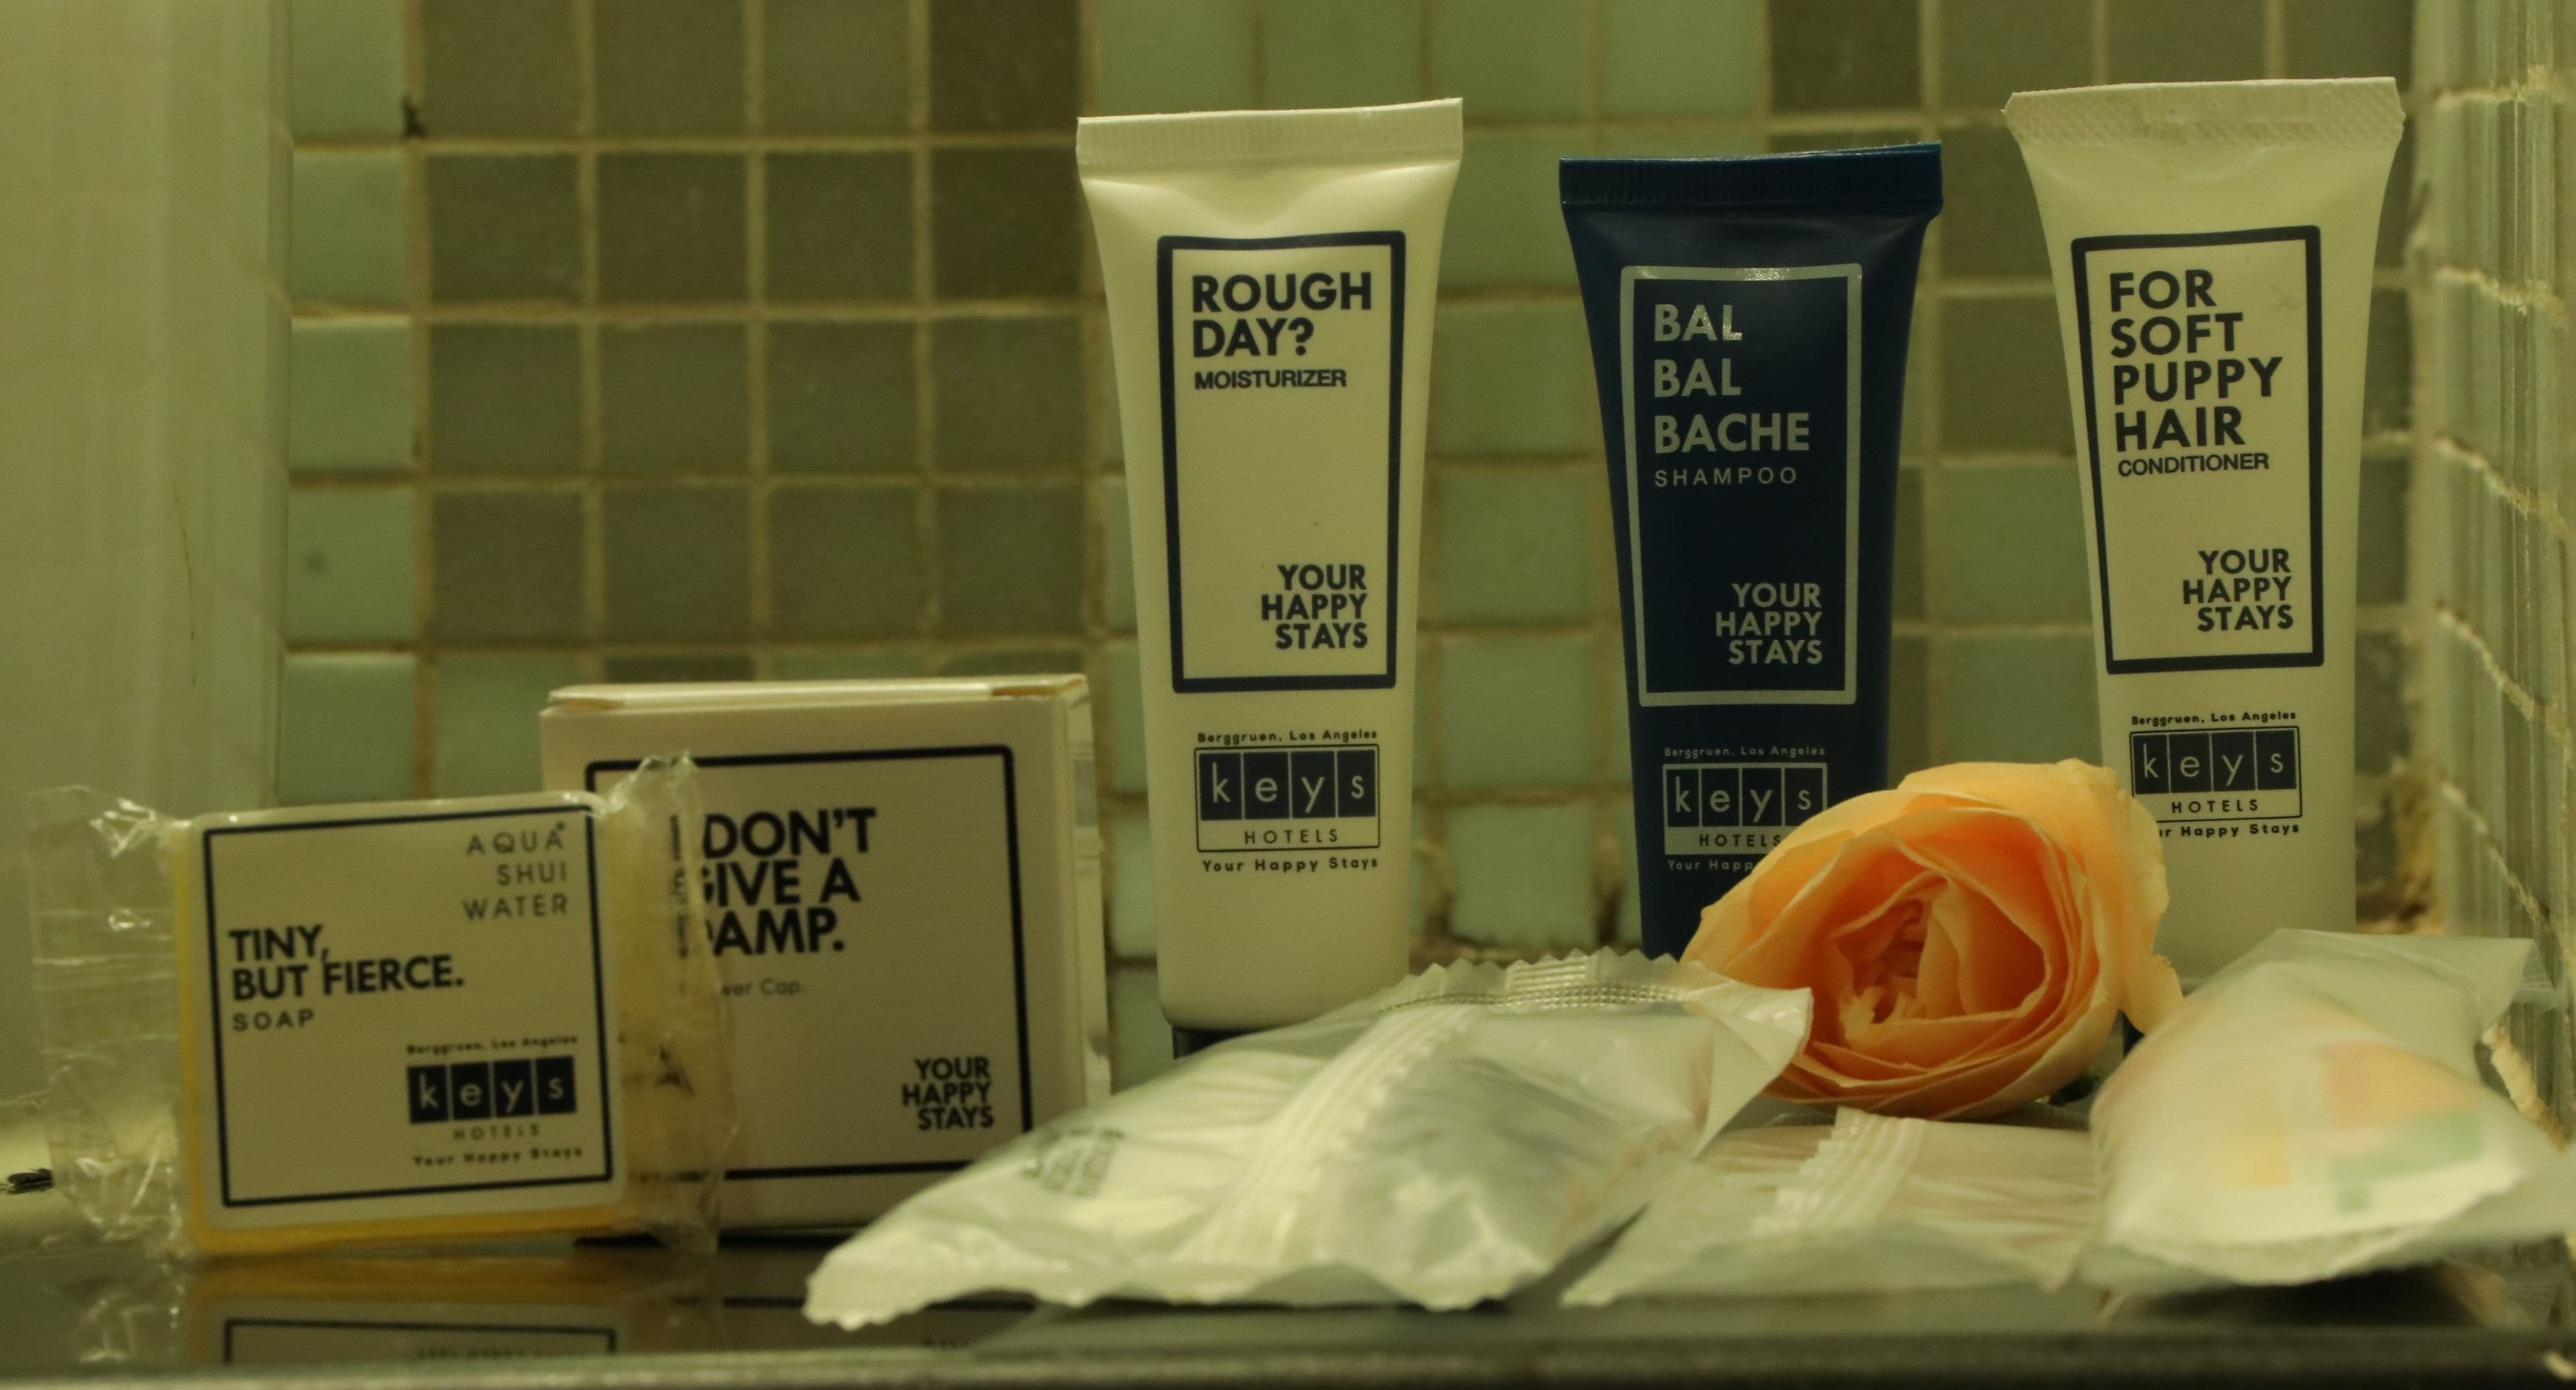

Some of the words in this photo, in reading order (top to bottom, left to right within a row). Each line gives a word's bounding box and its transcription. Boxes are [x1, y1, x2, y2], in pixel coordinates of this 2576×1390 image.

[1192, 272, 1372, 313] ROUGH
[2110, 269, 2217, 313] FOR
[1654, 304, 1743, 341] BAL
[2110, 312, 2244, 358] SOFT
[1193, 317, 1314, 358] DAY?
[1194, 369, 1347, 390] MOISTURIZER
[1654, 358, 1742, 397] BAL
[2113, 356, 2284, 406] PUPPY
[1654, 412, 1810, 454] BACHE
[2114, 406, 2246, 452] HAIR
[1654, 466, 1797, 488] SHAMPOO
[2117, 452, 2269, 477] CONDITIONER
[2198, 548, 2292, 576] YOUR
[1277, 564, 1367, 591] YOUR
[2182, 576, 2292, 604] HAPPY
[1260, 593, 1368, 621] HAPPY
[1731, 582, 1823, 608] YOUR
[1715, 611, 1823, 637] HAPPY
[2197, 604, 2294, 632] STAYS
[1275, 623, 1368, 650] STAYS
[1727, 639, 1823, 665] STAYS
[2210, 712, 2236, 723] Los
[2241, 710, 2297, 724] Angeles
[1197, 731, 1283, 746] Berggruen,
[1289, 730, 1316, 741] Los
[1322, 729, 1378, 743] Angeles
[1740, 746, 1765, 756] Los
[1770, 745, 1825, 758] Angeles
[2143, 743, 2284, 787] keys
[1212, 761, 1365, 814] keys
[1674, 776, 1812, 823] keys
[2171, 799, 2259, 814] HOTELS
[466, 828, 564, 857] AQUA
[702, 806, 877, 859] DON'T
[1244, 828, 1338, 845] HOTELS
[1699, 834, 1782, 848] HOTELS
[2180, 825, 2240, 838] Happy
[2249, 823, 2300, 835] Stays
[496, 861, 568, 886] SHUI
[1202, 859, 1244, 872] Your
[1254, 859, 1319, 873] Happy
[1328, 857, 1379, 870] Stays
[1667, 859, 1701, 871] Your
[1709, 859, 1754, 872] Happ
[818, 857, 862, 904] A
[462, 892, 569, 922] WATER
[228, 924, 329, 963] TINY,
[706, 907, 846, 957] AMP.
[232, 964, 309, 1001] BUT
[321, 953, 465, 996] FIERCE.
[232, 1008, 315, 1032] SOAP
[914, 1056, 991, 1081] YOUR
[419, 1072, 564, 1114] keys
[901, 1081, 993, 1107] HAPPY
[917, 1106, 996, 1131] STAYS
